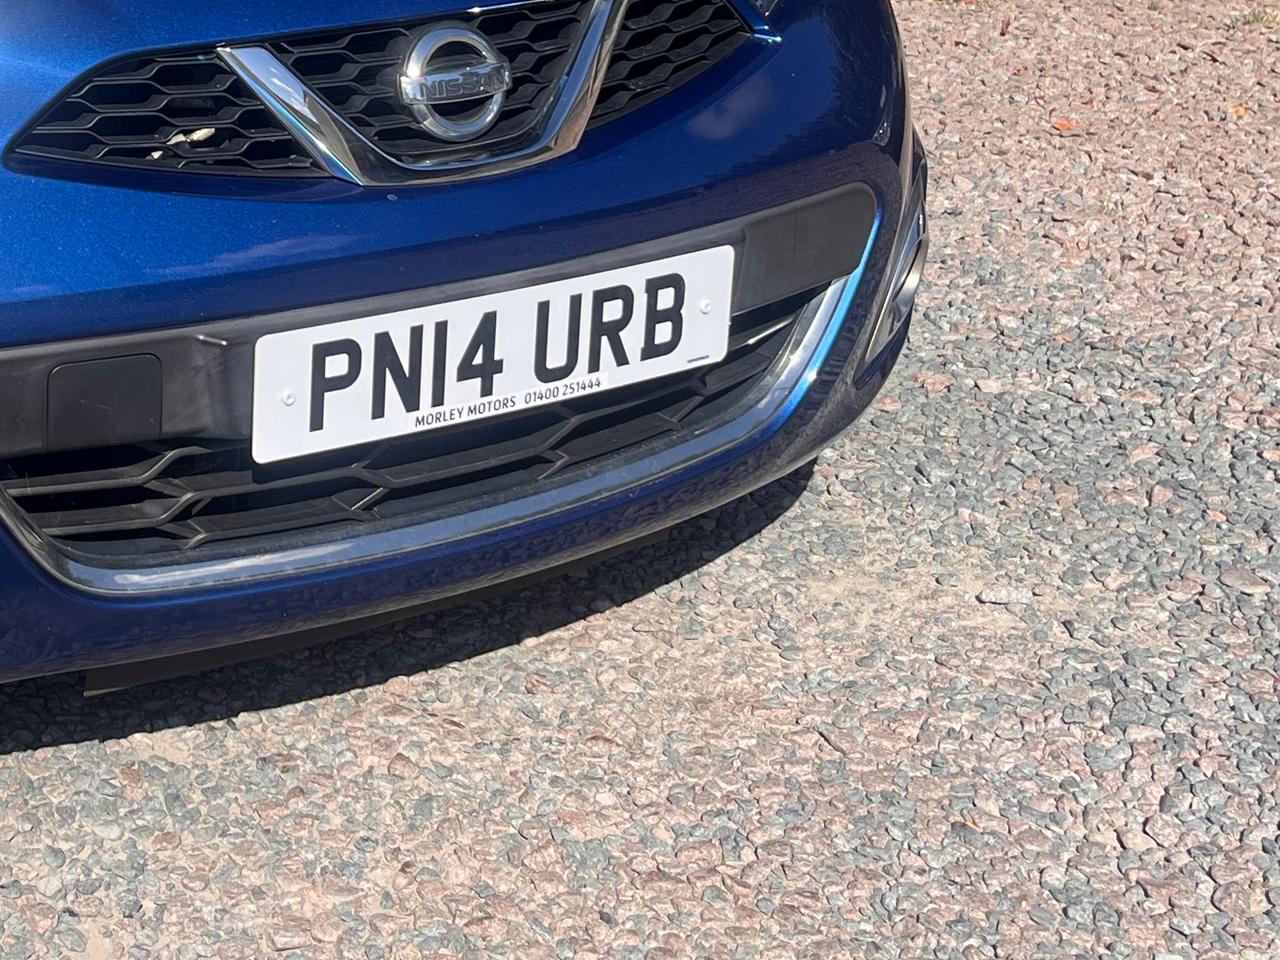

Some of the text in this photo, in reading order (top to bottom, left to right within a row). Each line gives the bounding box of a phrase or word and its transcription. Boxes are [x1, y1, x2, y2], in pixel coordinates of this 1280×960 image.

[420, 67, 506, 102] NISSAN
[308, 272, 686, 432] PN14 URB
[415, 377, 602, 427] MORLEY MOTORS 01400 251444
